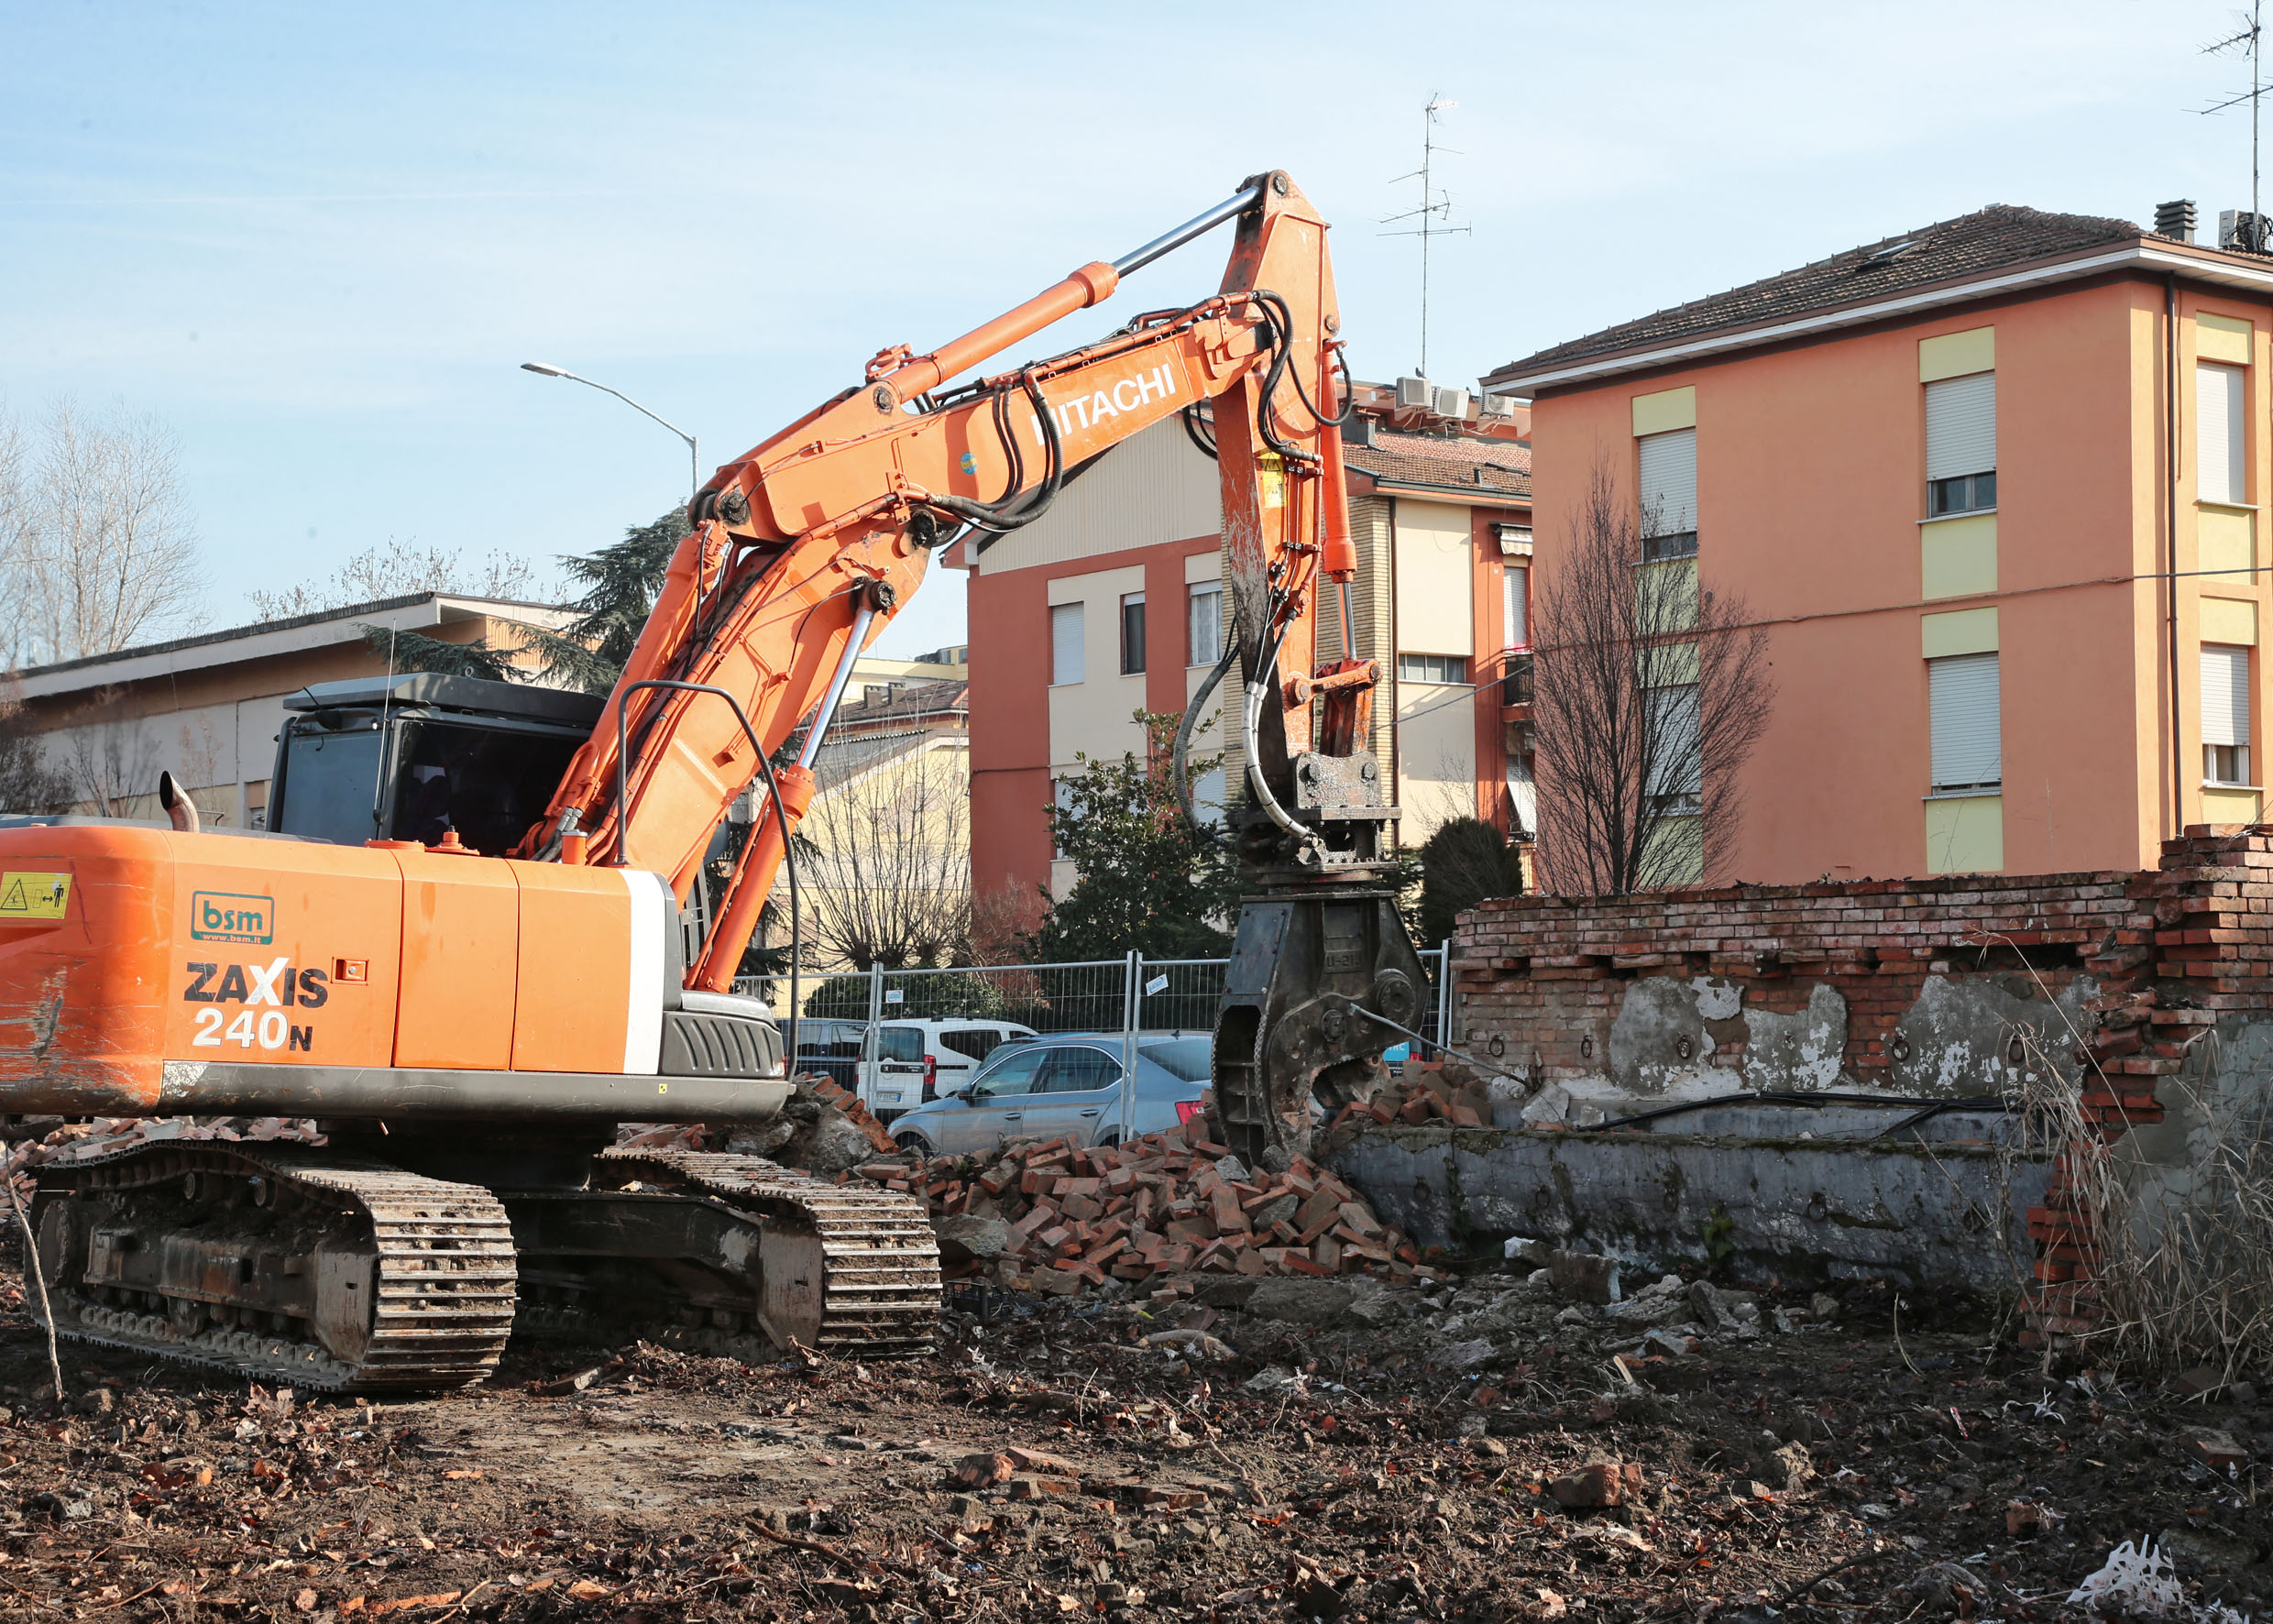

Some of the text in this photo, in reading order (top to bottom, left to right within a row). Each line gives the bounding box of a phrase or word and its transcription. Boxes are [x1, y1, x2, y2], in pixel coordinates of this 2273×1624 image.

[203, 900, 262, 931] bsm
[203, 934, 261, 944] www.bsm.it
[184, 958, 328, 1008] ZAXIS
